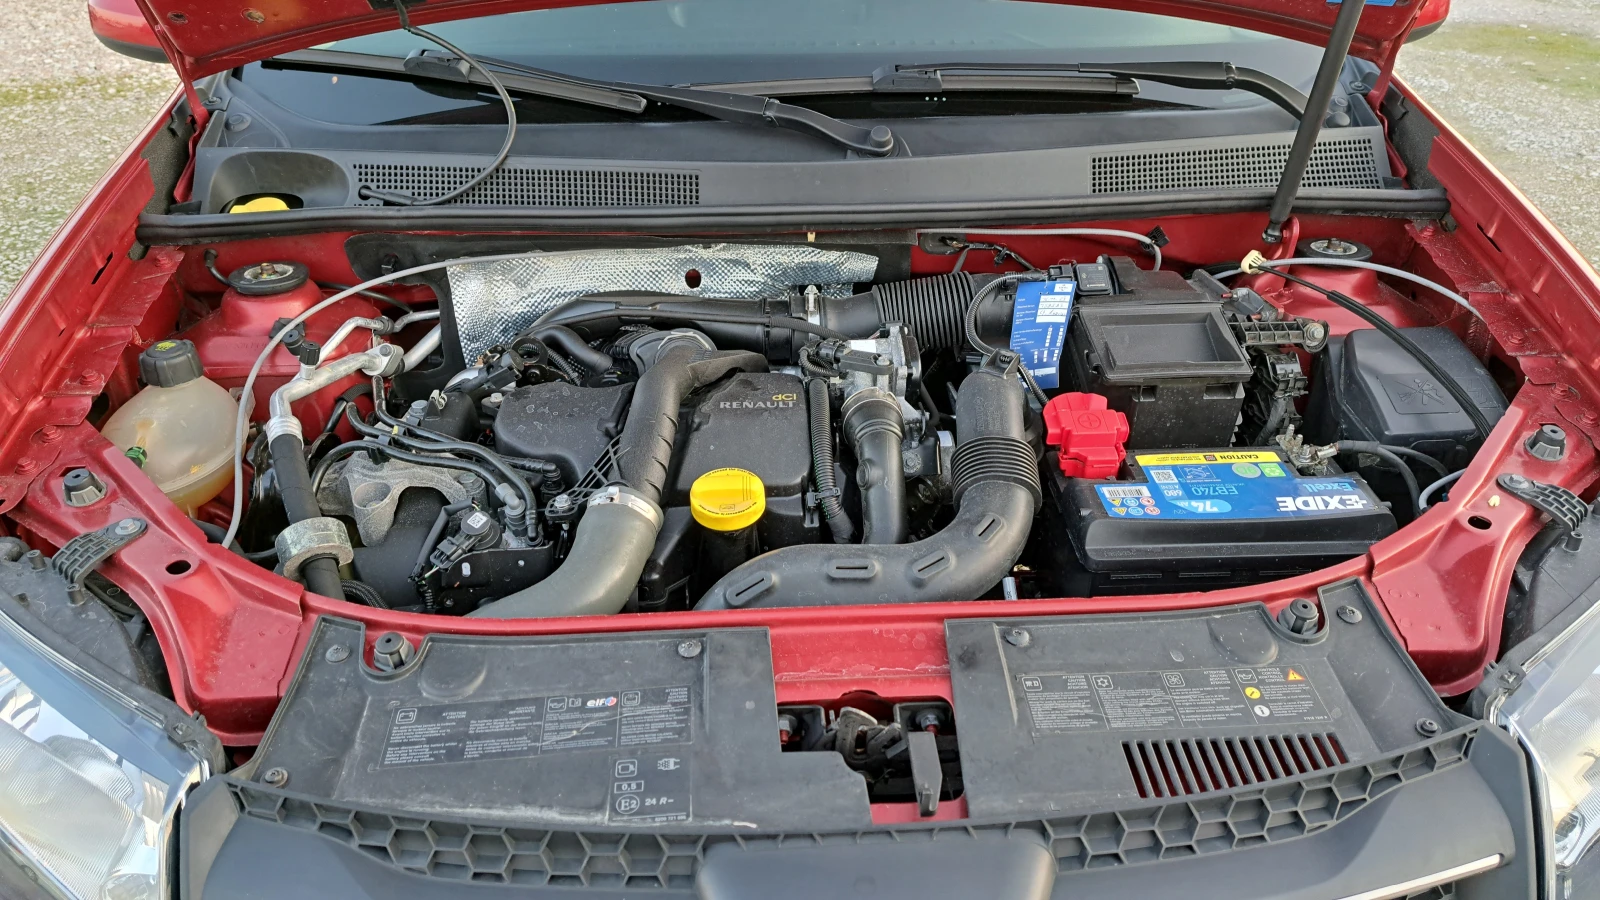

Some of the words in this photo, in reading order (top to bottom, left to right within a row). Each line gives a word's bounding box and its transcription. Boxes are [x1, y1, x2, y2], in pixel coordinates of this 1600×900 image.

[720, 401, 796, 409] RENAULT
[1192, 485, 1239, 496] EB740
[1303, 482, 1354, 493] Excell
[1190, 500, 1219, 512] 74
[1275, 494, 1368, 512] EXIDE
[586, 699, 606, 707] elf
[621, 783, 637, 791] 0,5
[620, 799, 637, 810] E2
[644, 798, 657, 806] 24
